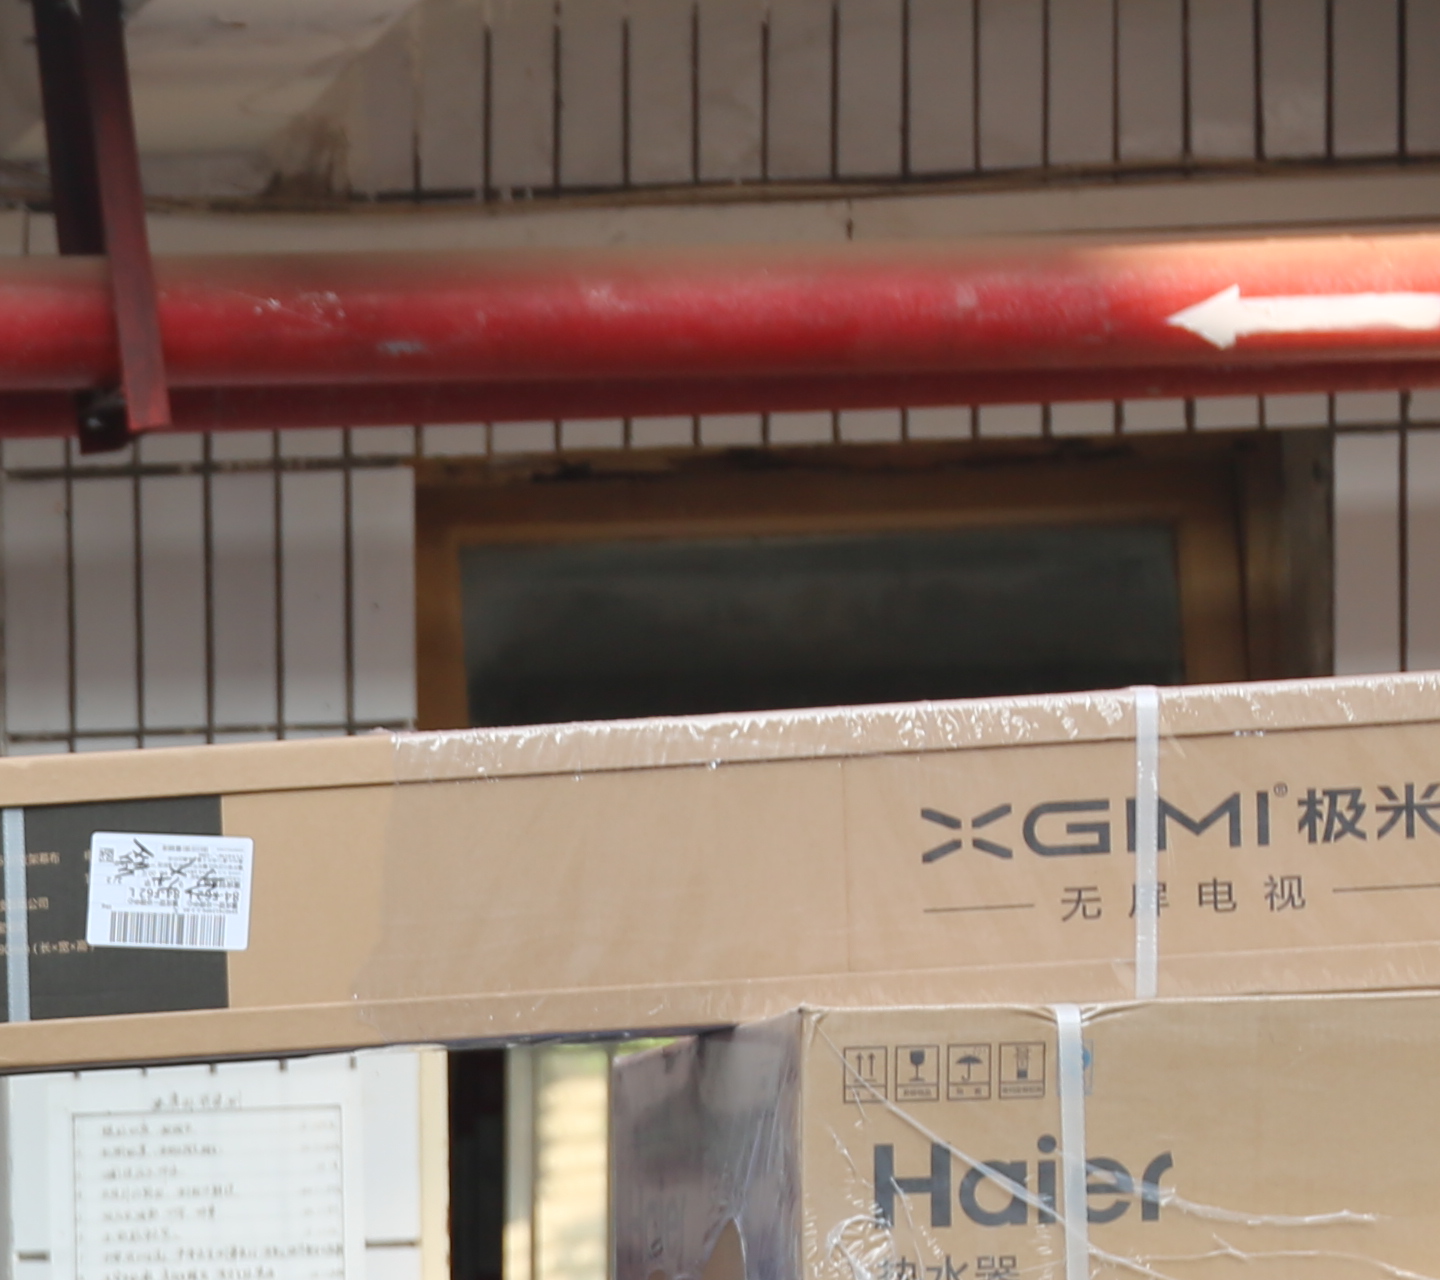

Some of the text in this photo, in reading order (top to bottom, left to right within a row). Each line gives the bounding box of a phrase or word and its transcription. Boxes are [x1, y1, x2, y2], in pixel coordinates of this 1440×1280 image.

[920, 782, 1440, 864] XGIMI 极米
[873, 1133, 1174, 1229] Haier
